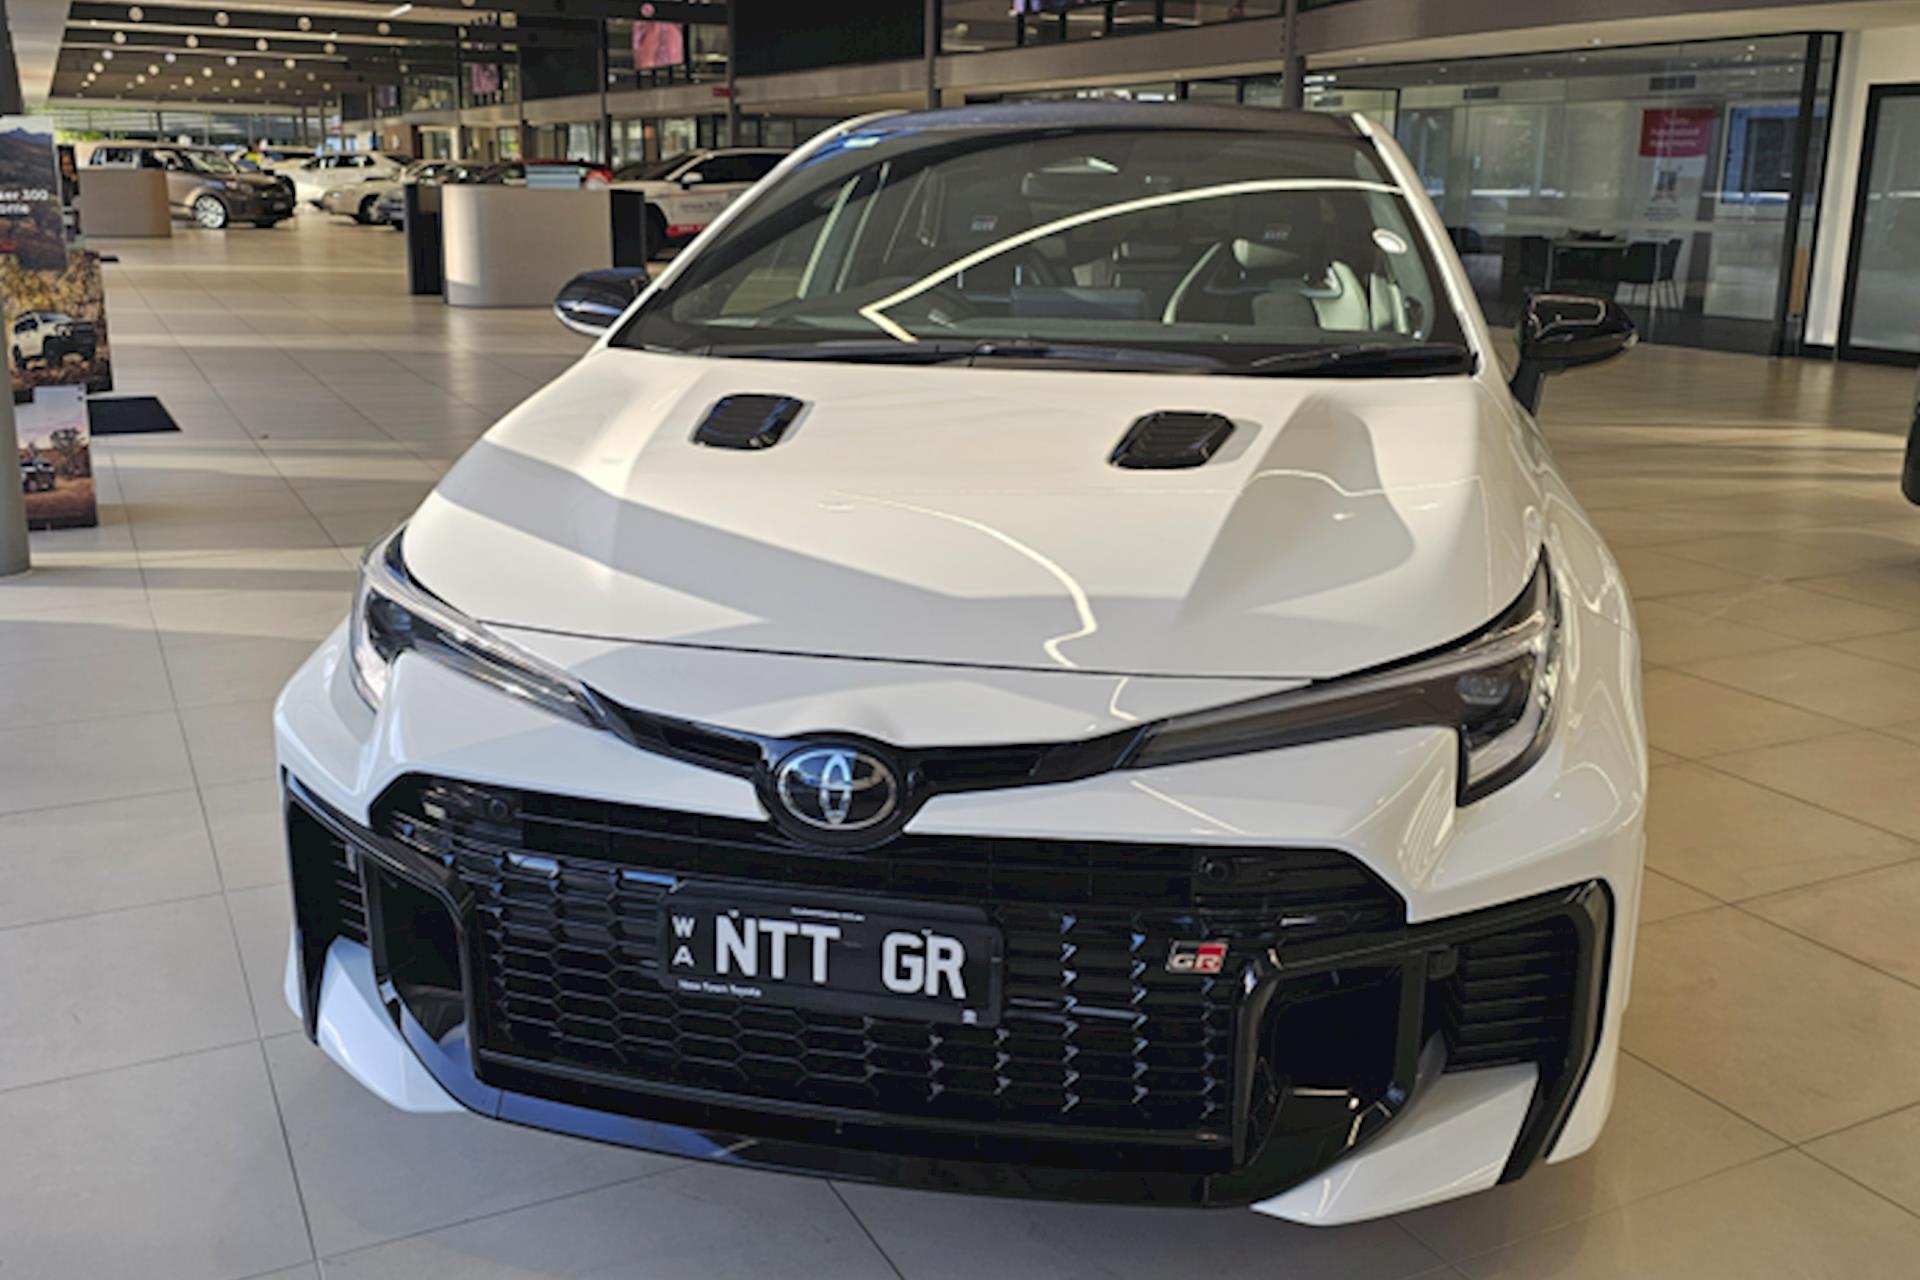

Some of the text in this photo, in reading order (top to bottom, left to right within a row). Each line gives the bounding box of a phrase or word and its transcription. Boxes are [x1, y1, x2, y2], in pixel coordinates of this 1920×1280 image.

[714, 914, 967, 999] NTT GR
[1168, 950, 1223, 974] GR
